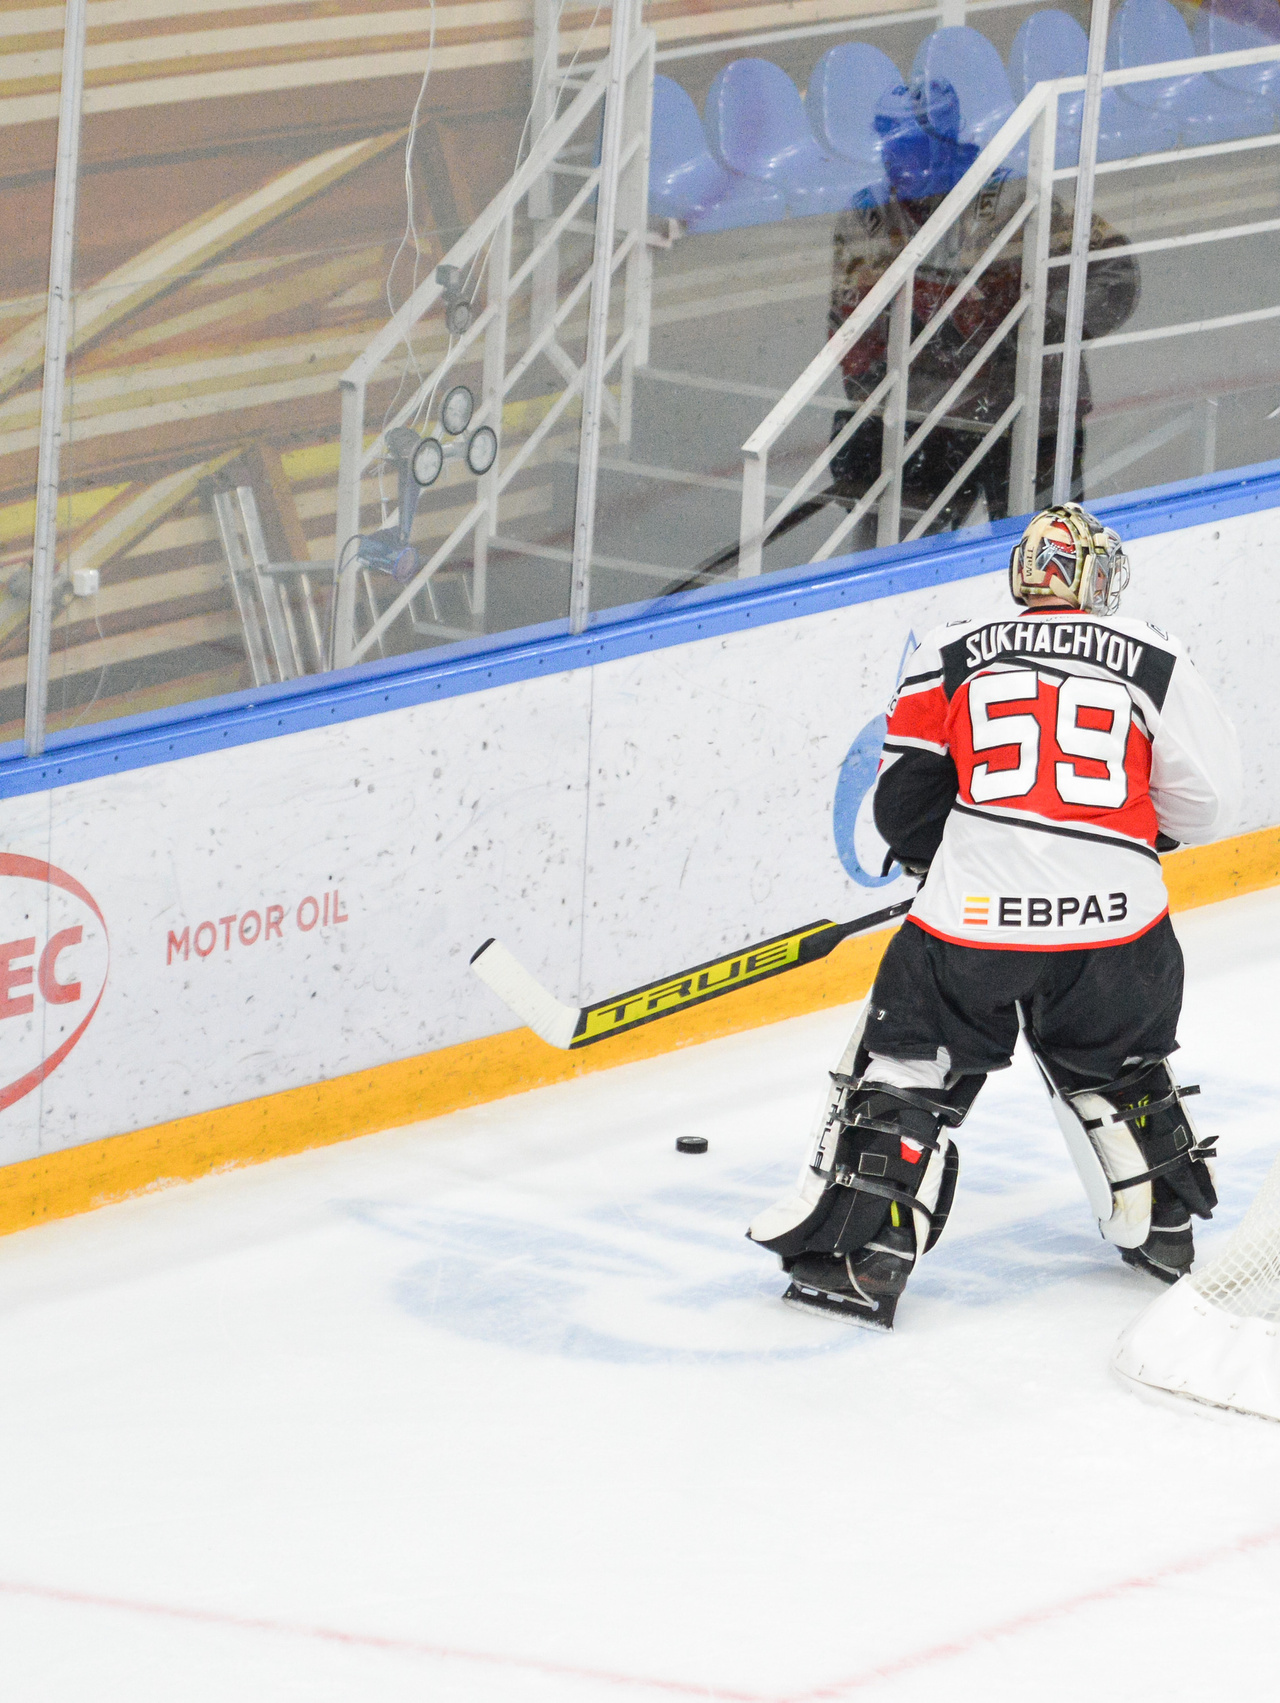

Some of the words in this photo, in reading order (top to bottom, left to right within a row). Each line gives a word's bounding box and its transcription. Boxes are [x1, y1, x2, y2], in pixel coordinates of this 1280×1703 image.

[965, 622, 1143, 678] SUKHACHYOV
[968, 669, 1134, 809] 59
[166, 904, 285, 966] MOTOR
[296, 889, 349, 932] OIL
[997, 892, 1128, 928] ЕВРАЗ
[596, 941, 790, 1024] TRUE
